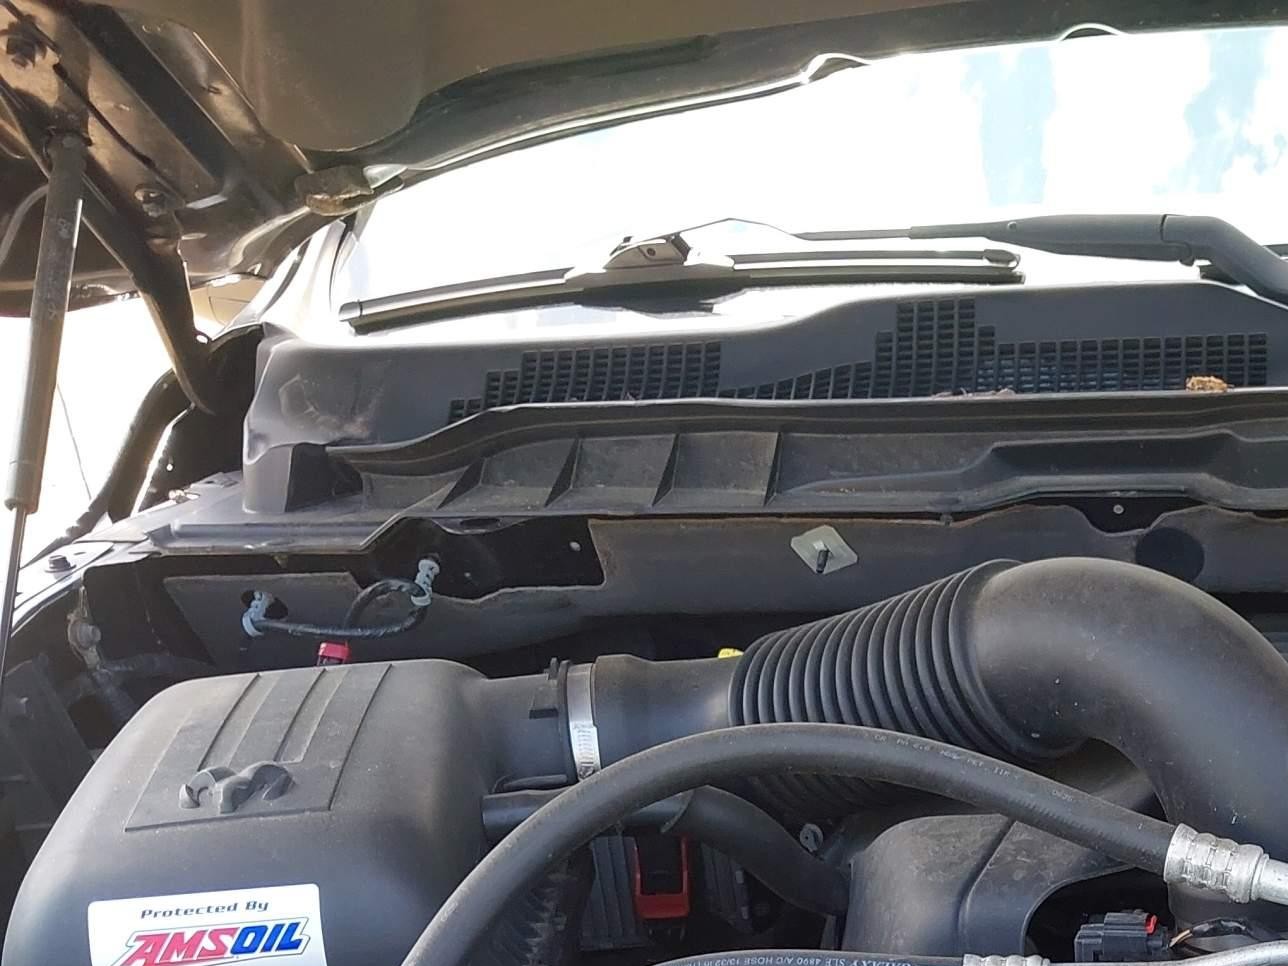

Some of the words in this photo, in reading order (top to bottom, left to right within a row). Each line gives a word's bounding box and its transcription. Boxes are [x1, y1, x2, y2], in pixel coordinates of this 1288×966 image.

[140, 902, 238, 920] Protected
[244, 900, 270, 913] By
[743, 956, 773, 966] HOSE
